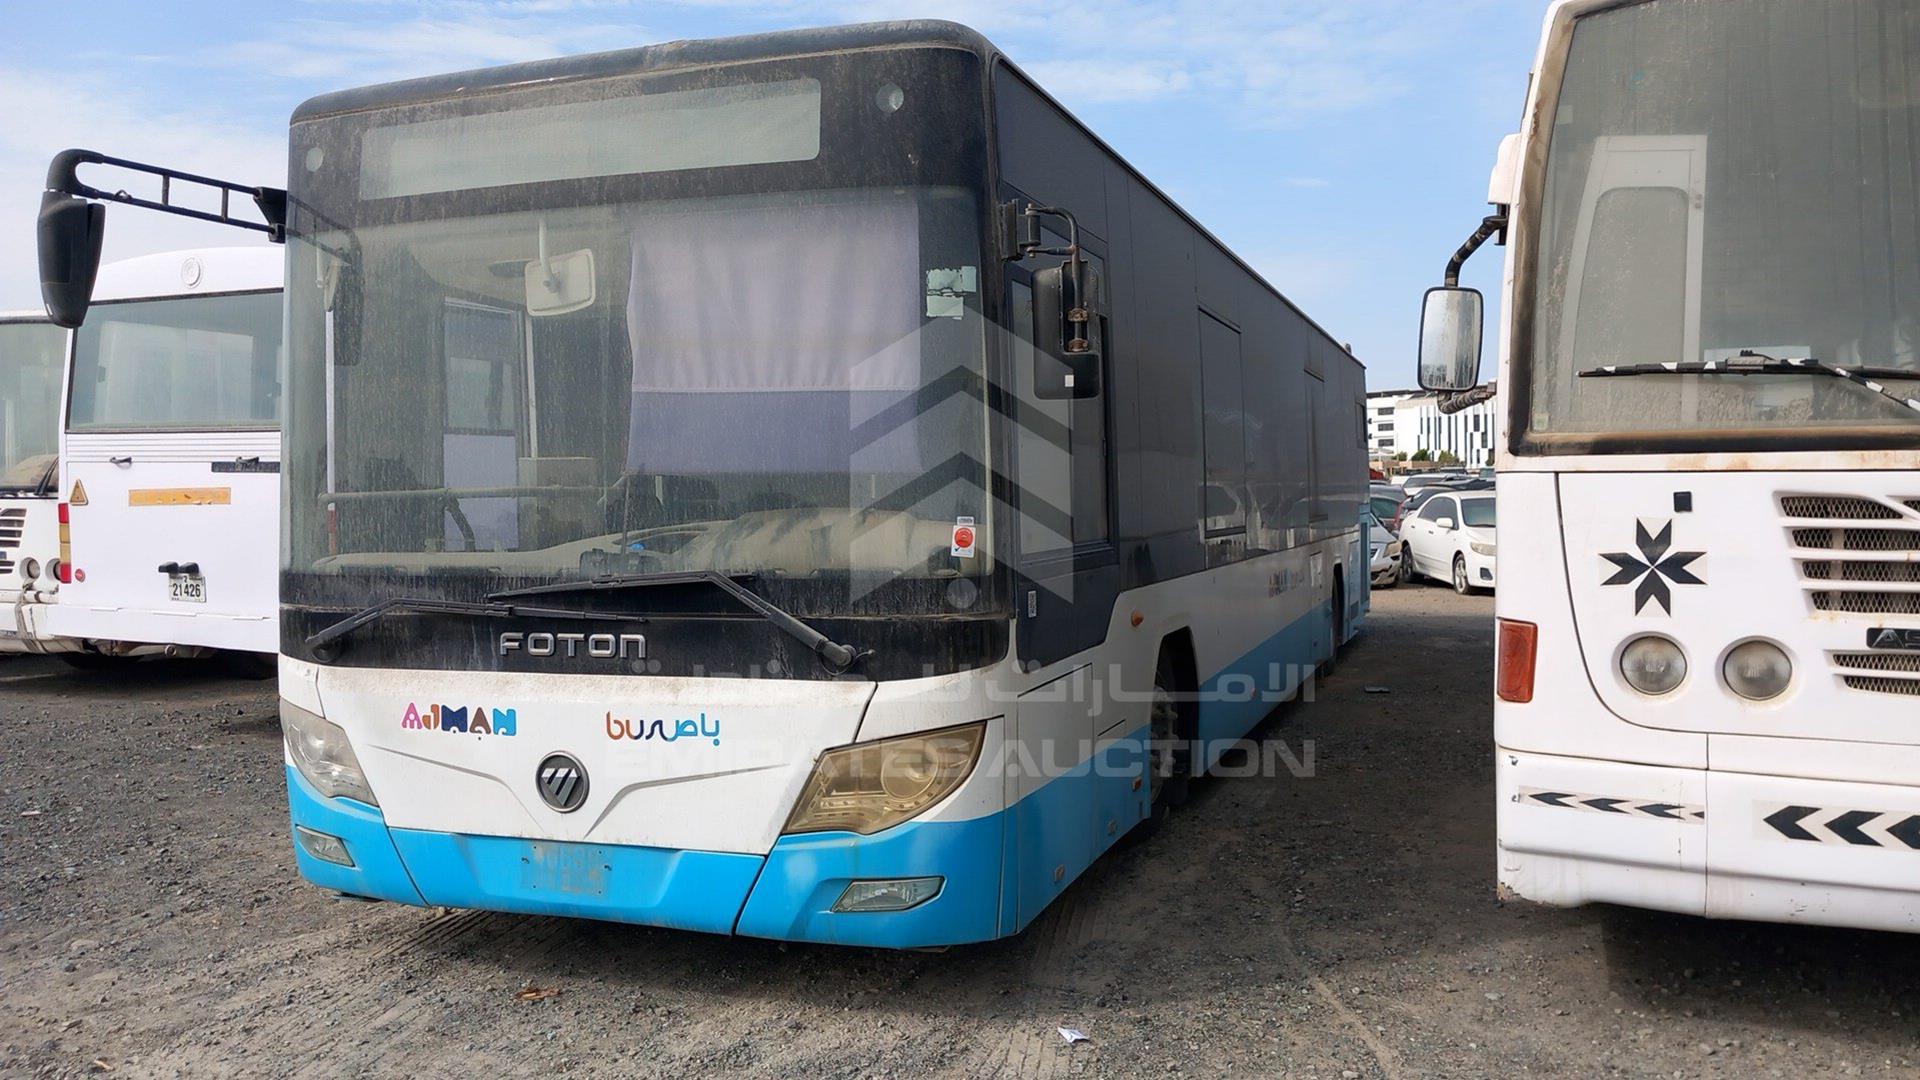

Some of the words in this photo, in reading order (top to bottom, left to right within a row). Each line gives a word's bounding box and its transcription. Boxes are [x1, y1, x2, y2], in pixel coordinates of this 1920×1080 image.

[172, 583, 201, 597] 21426
[500, 632, 646, 659] FOTON
[401, 702, 517, 740] AJMAN
